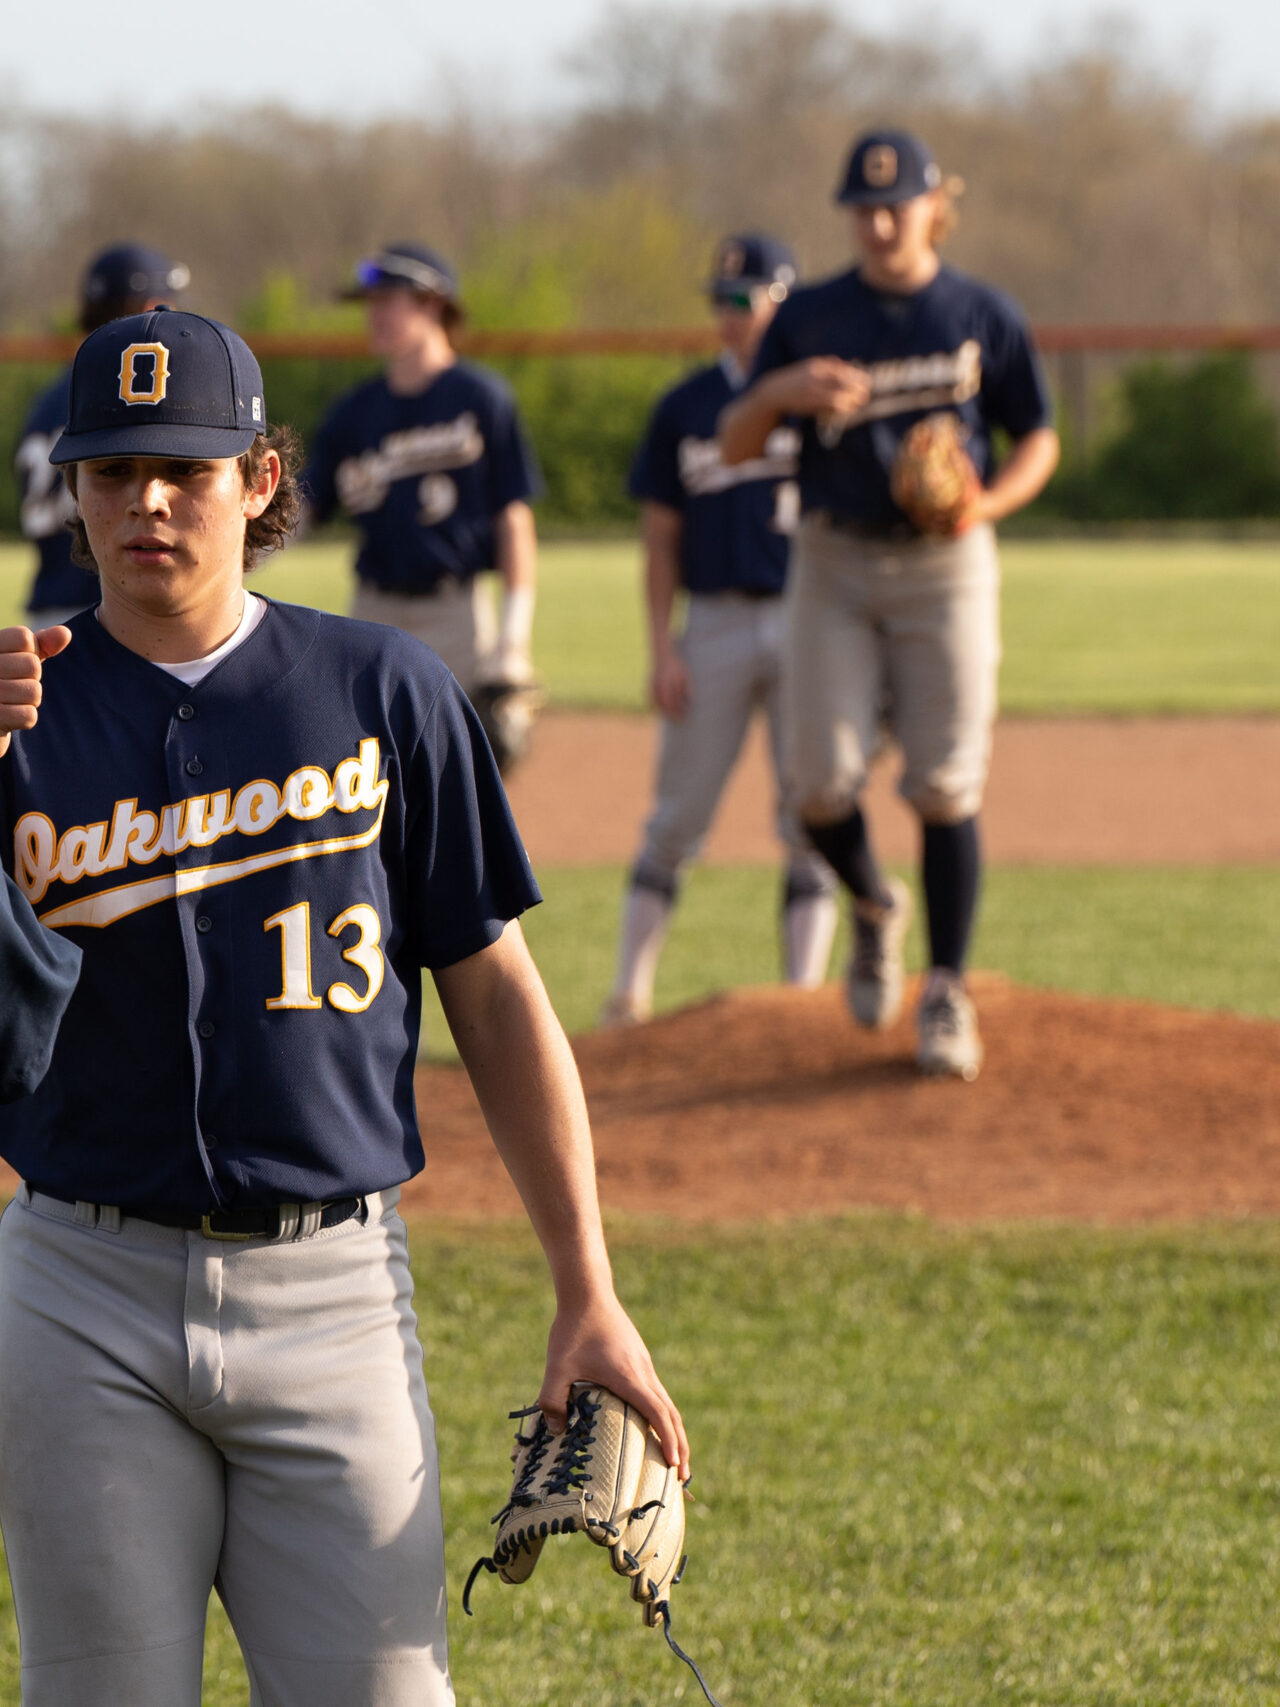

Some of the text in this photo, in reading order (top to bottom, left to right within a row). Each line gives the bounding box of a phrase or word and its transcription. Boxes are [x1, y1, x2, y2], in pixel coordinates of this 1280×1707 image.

[117, 341, 171, 406] O
[14, 738, 388, 904] Oakwood
[264, 902, 384, 1013] 13
